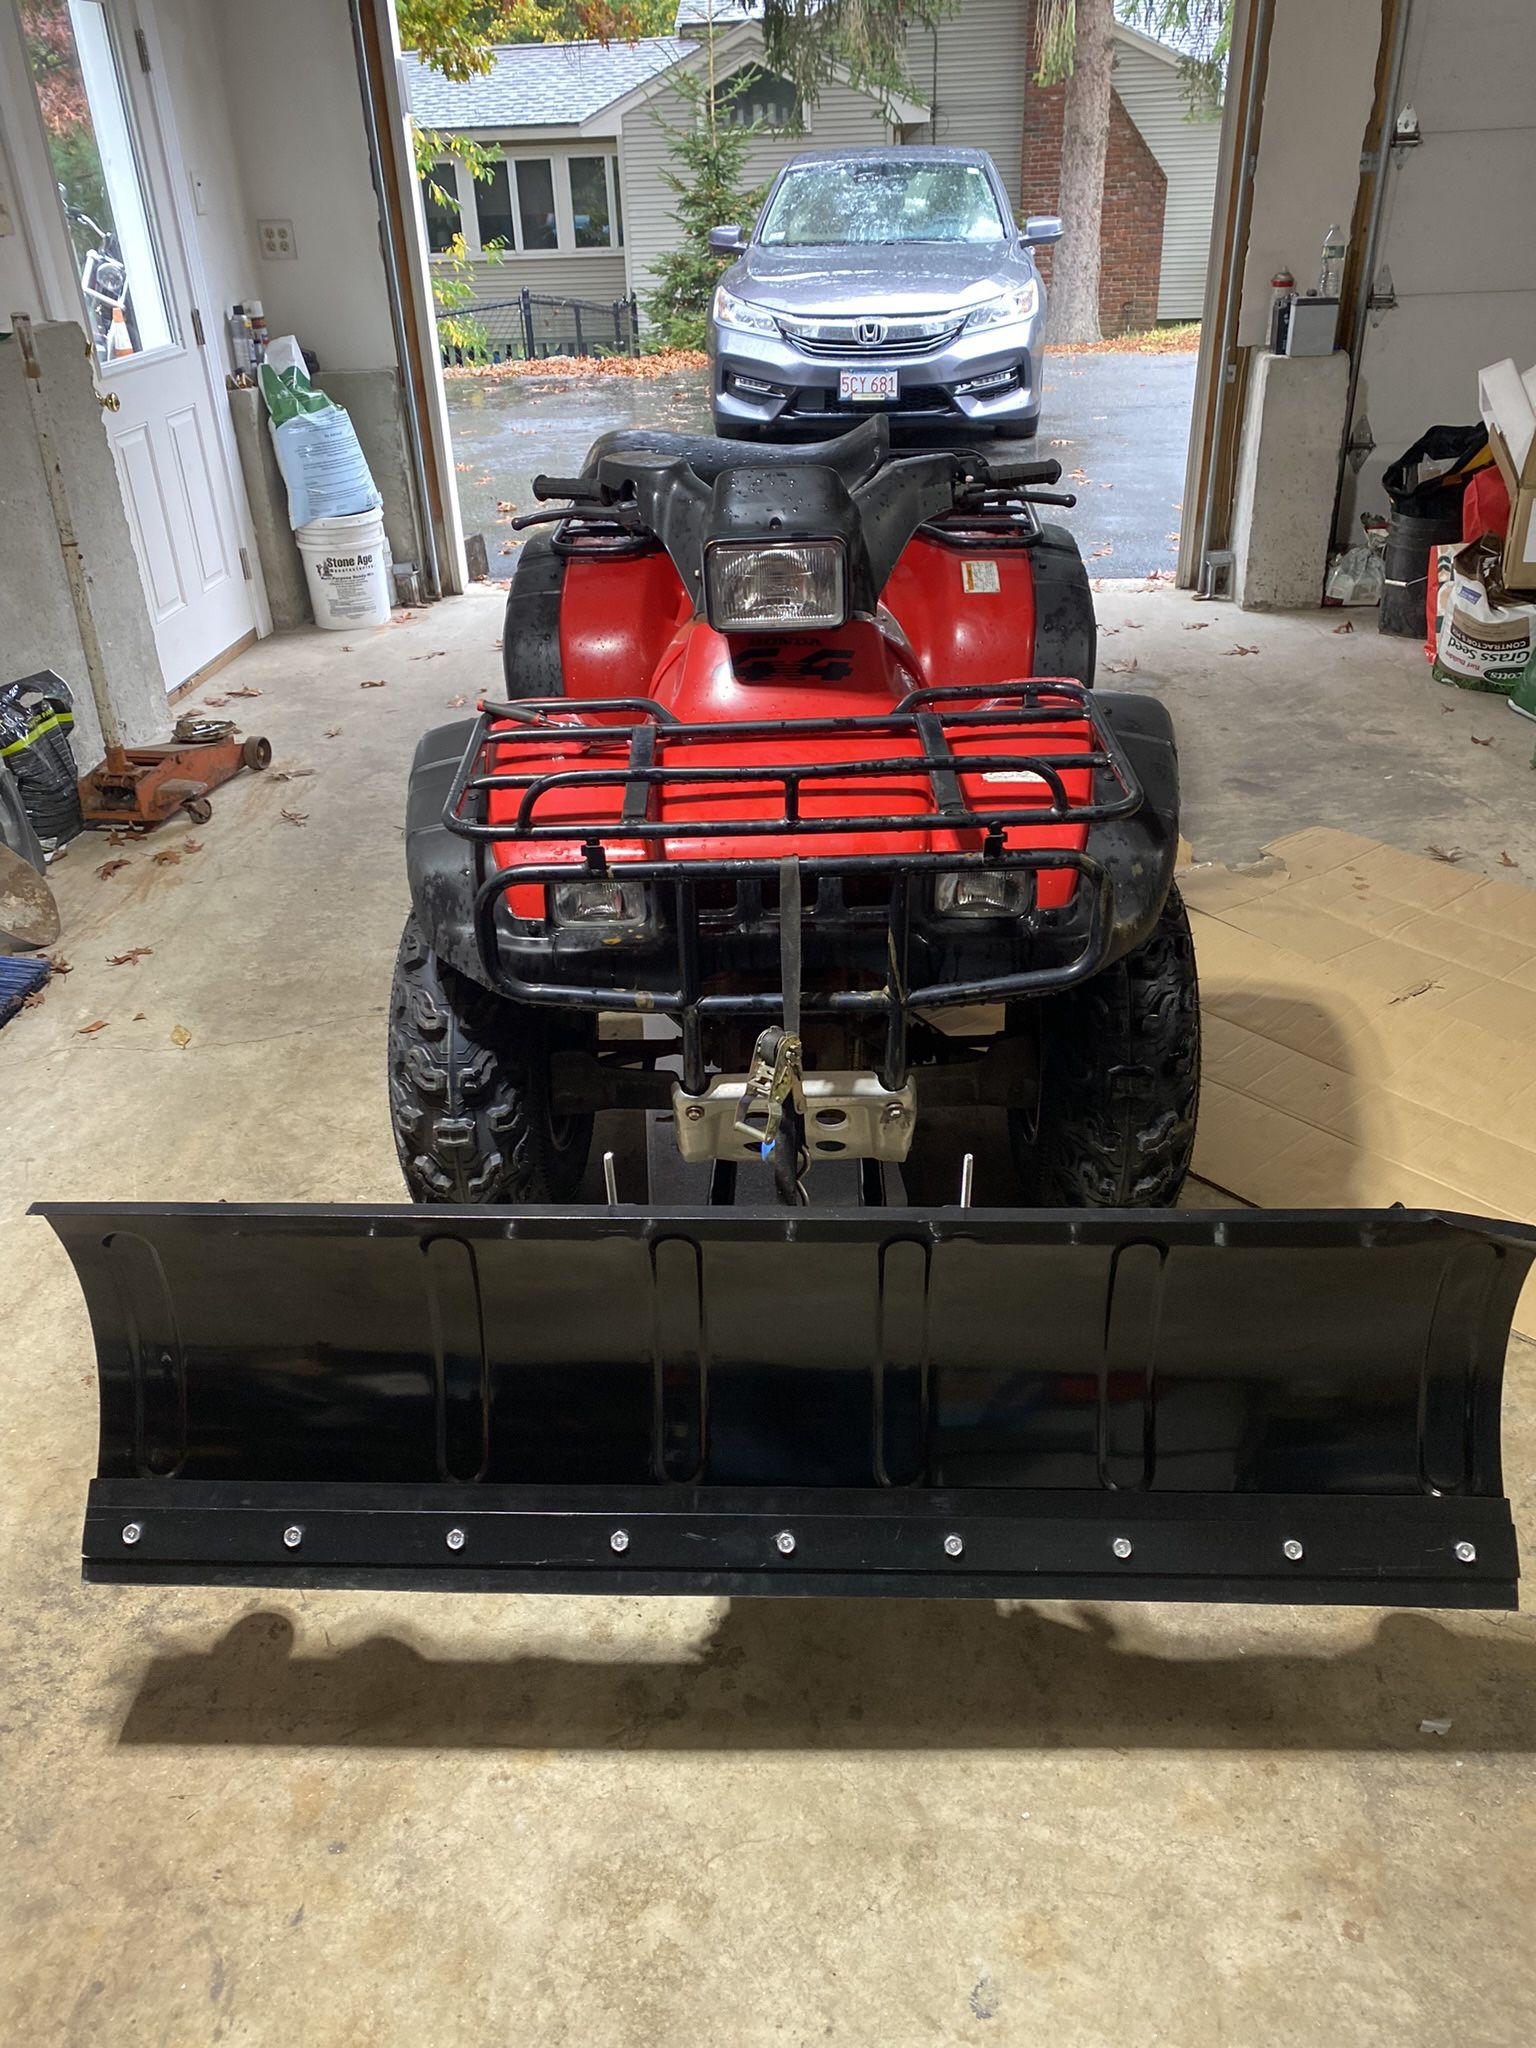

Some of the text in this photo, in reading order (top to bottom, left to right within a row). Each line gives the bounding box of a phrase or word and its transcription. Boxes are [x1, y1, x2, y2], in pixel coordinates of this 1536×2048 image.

[842, 376, 895, 393] 5CY 681
[326, 554, 373, 568] Stone Age
[748, 637, 822, 646] HONDA
[1448, 638, 1530, 664] Grass Seed
[1466, 662, 1481, 671] Turf
[1490, 672, 1525, 680] cotts
